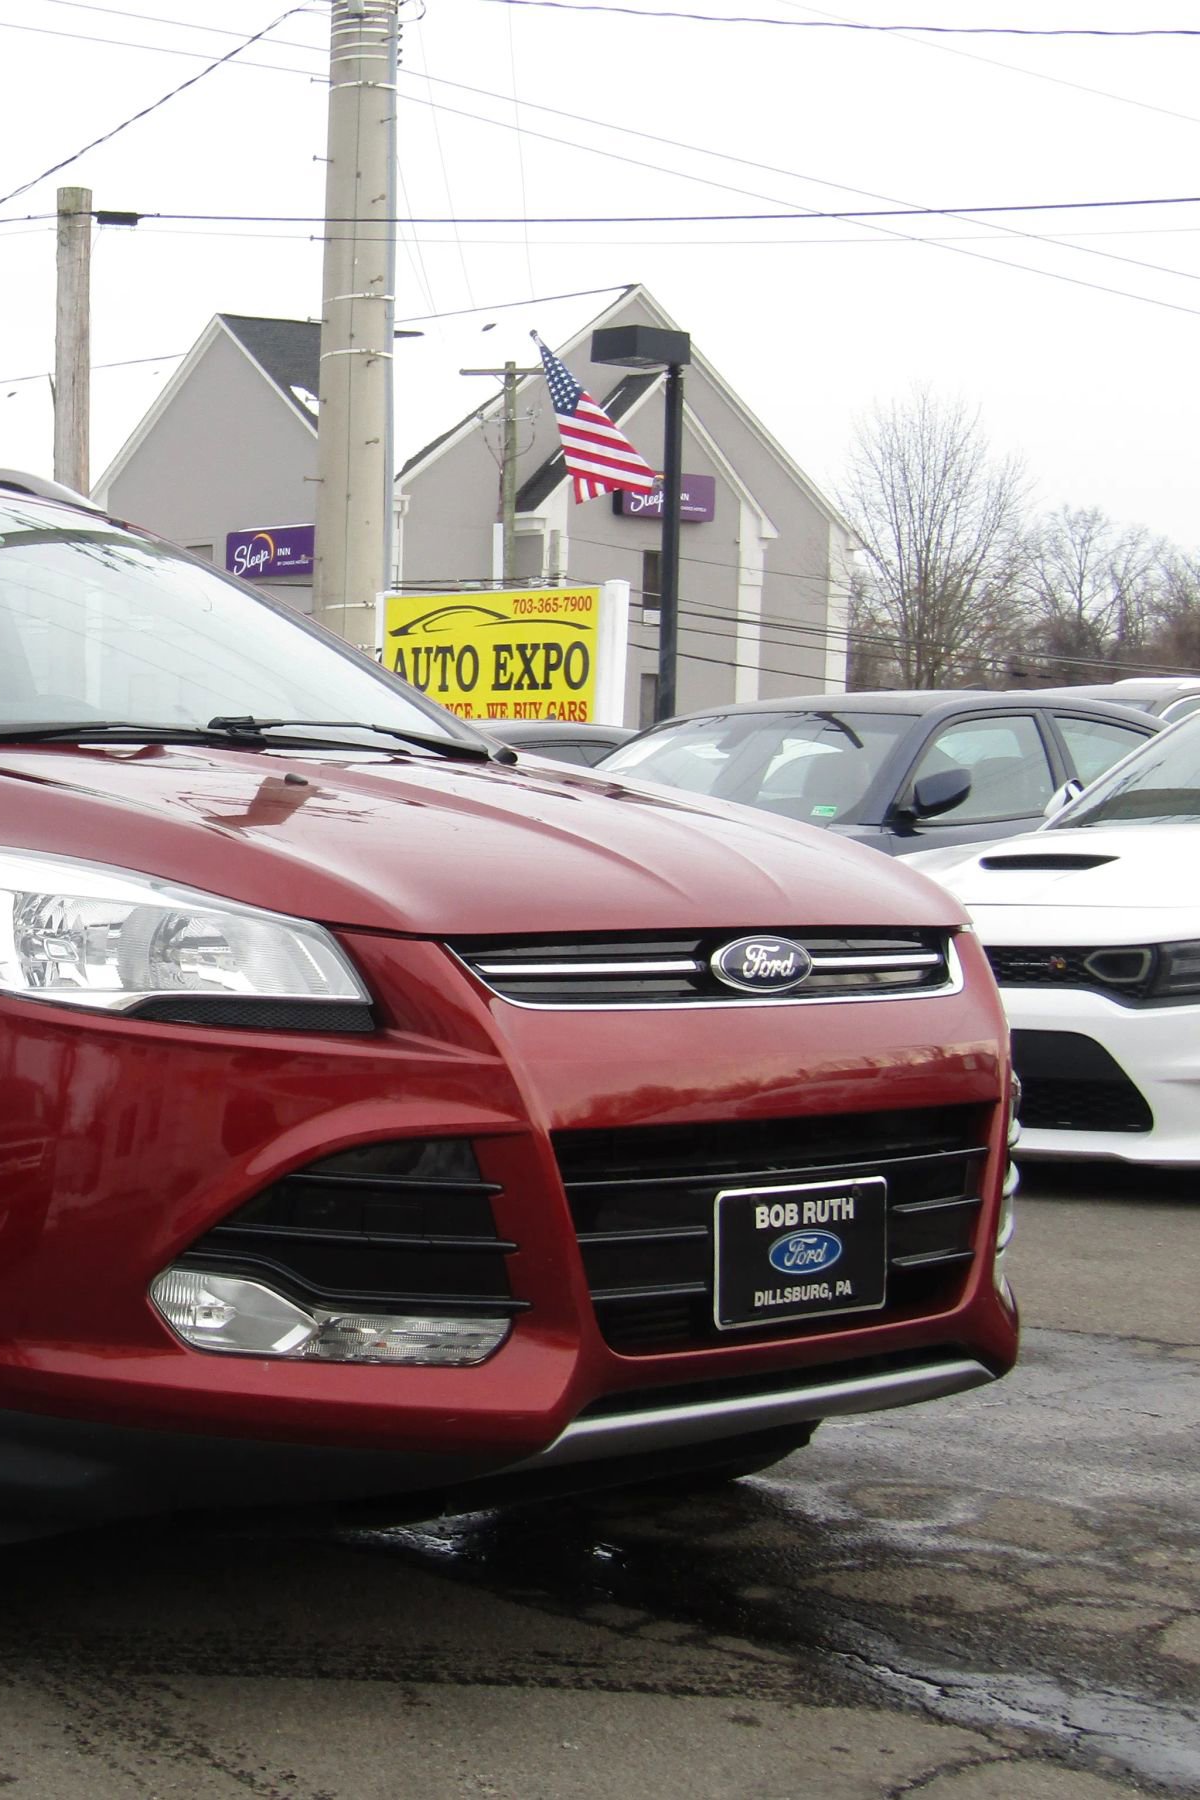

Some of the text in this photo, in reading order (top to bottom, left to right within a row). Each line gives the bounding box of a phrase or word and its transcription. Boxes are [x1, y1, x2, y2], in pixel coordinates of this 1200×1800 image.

[234, 544, 291, 575] Sleep INN
[512, 595, 593, 614] 703-365-7900
[393, 641, 590, 692] AUTO EXPO
[487, 702, 508, 719] WE
[513, 701, 543, 719] BUY
[547, 701, 588, 722] CARS
[742, 944, 796, 978] Ford
[755, 1197, 854, 1229] BOB RUTH
[784, 1237, 828, 1266] Ford
[754, 1280, 853, 1307] DILLSBURG, PA
